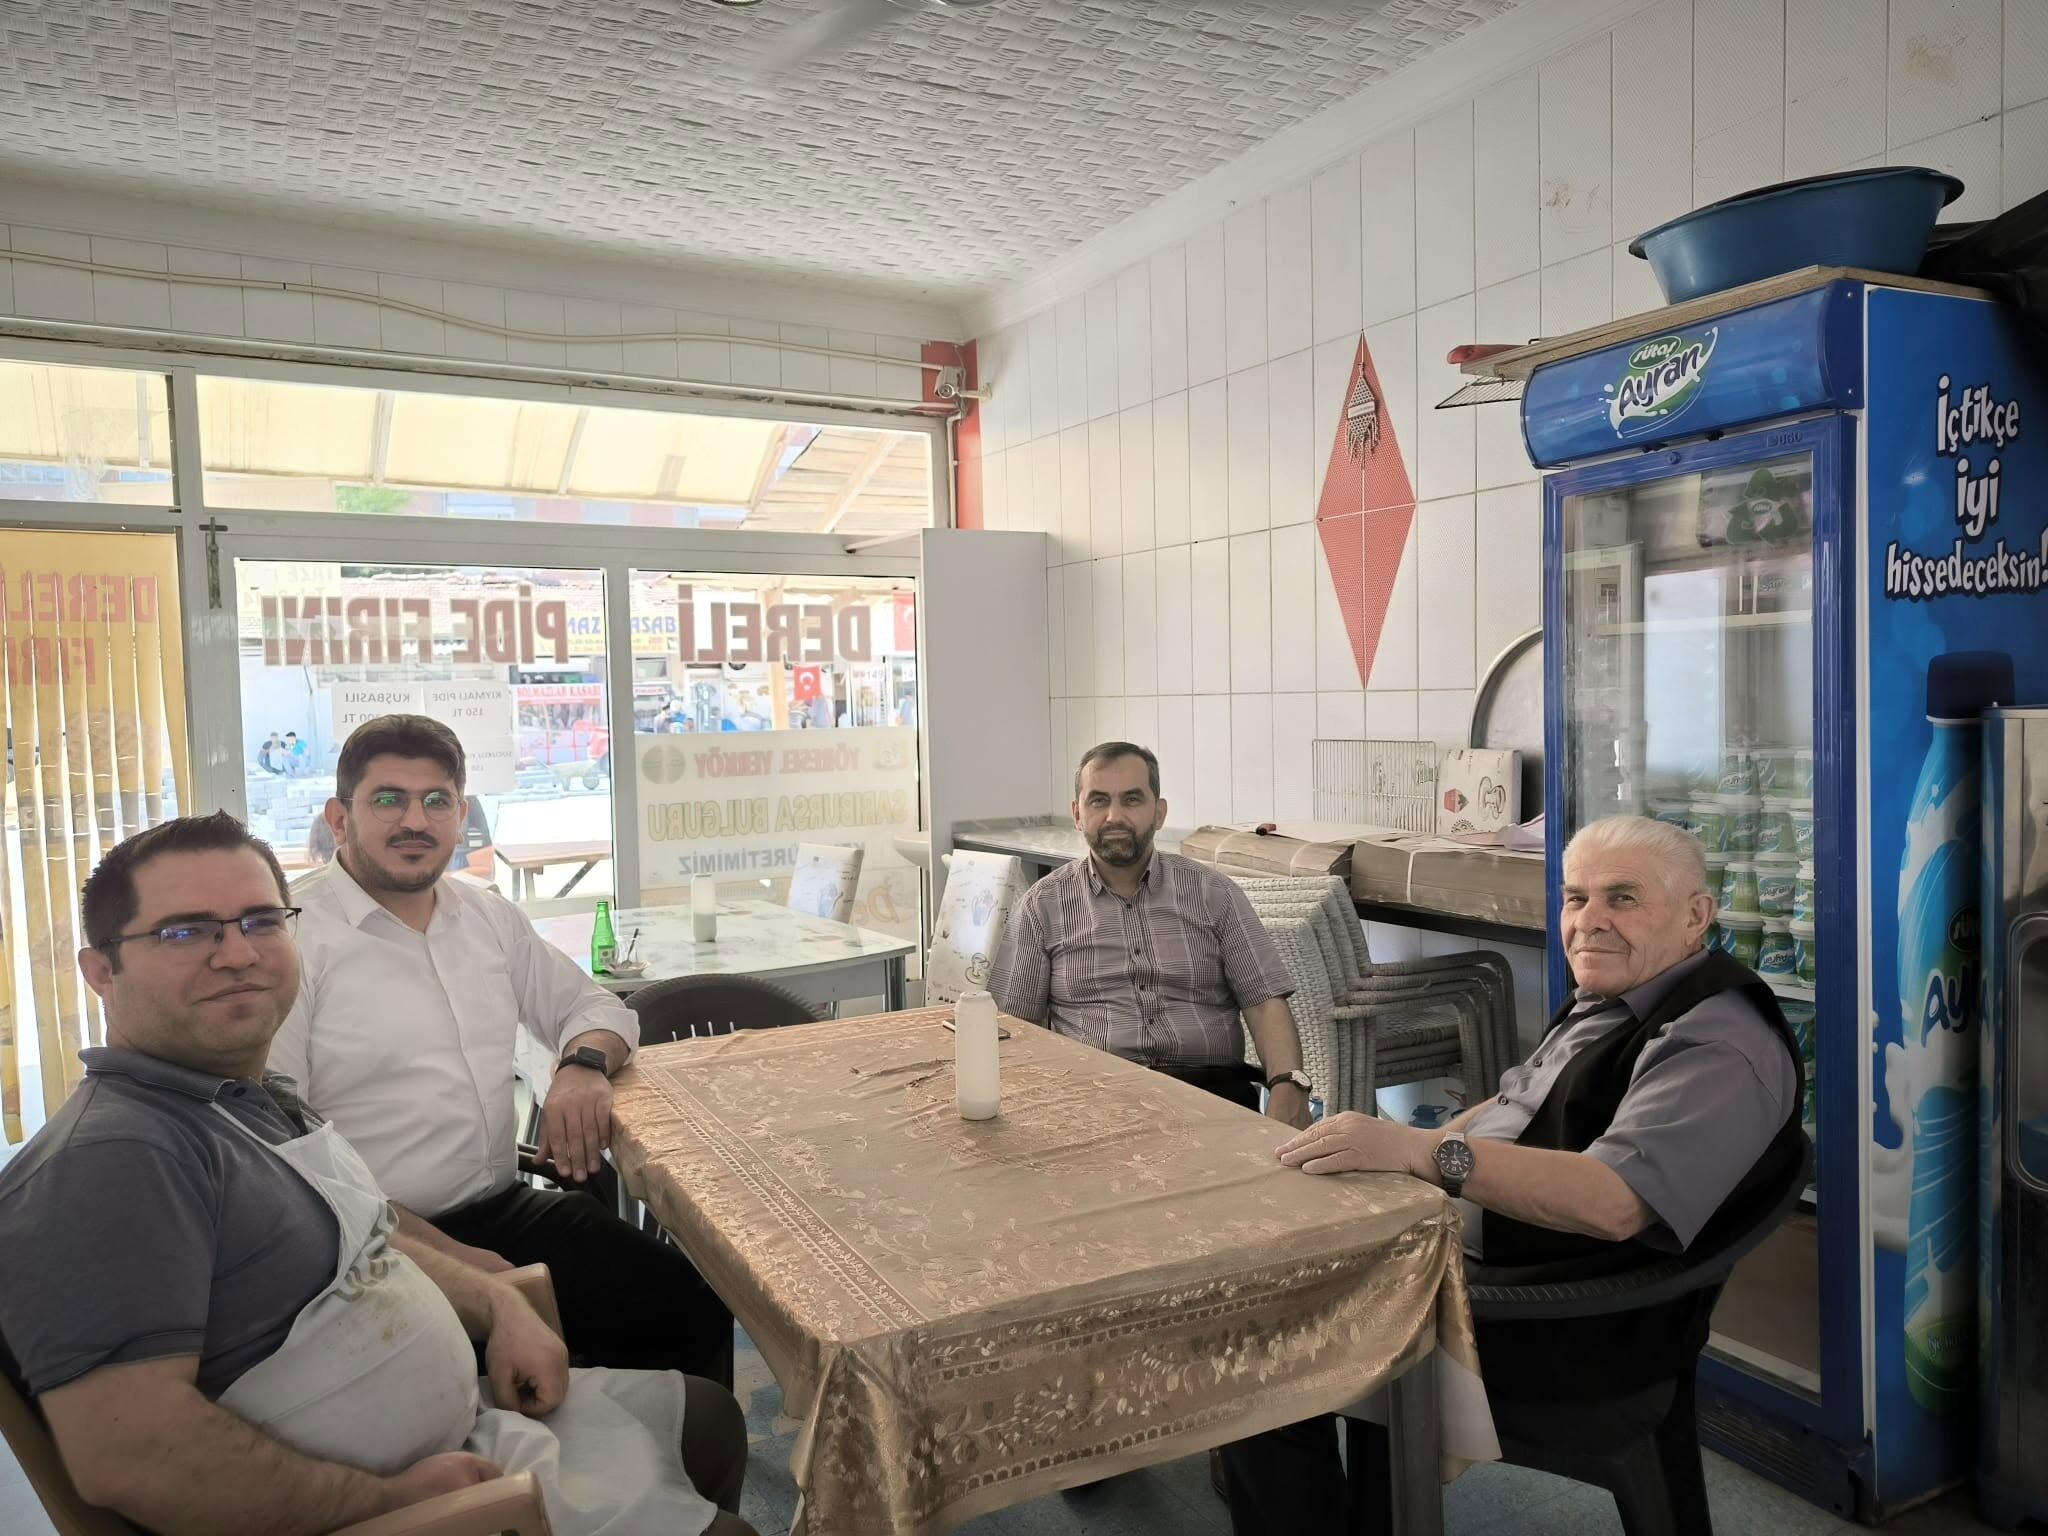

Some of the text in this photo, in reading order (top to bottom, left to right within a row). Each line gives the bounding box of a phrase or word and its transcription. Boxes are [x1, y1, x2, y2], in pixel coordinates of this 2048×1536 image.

[1618, 345, 1702, 417] Ayran
[1936, 374, 2020, 454] İçtikçe
[1956, 457, 2001, 537] iyi
[1886, 528, 2048, 597] hissedeceksin!
